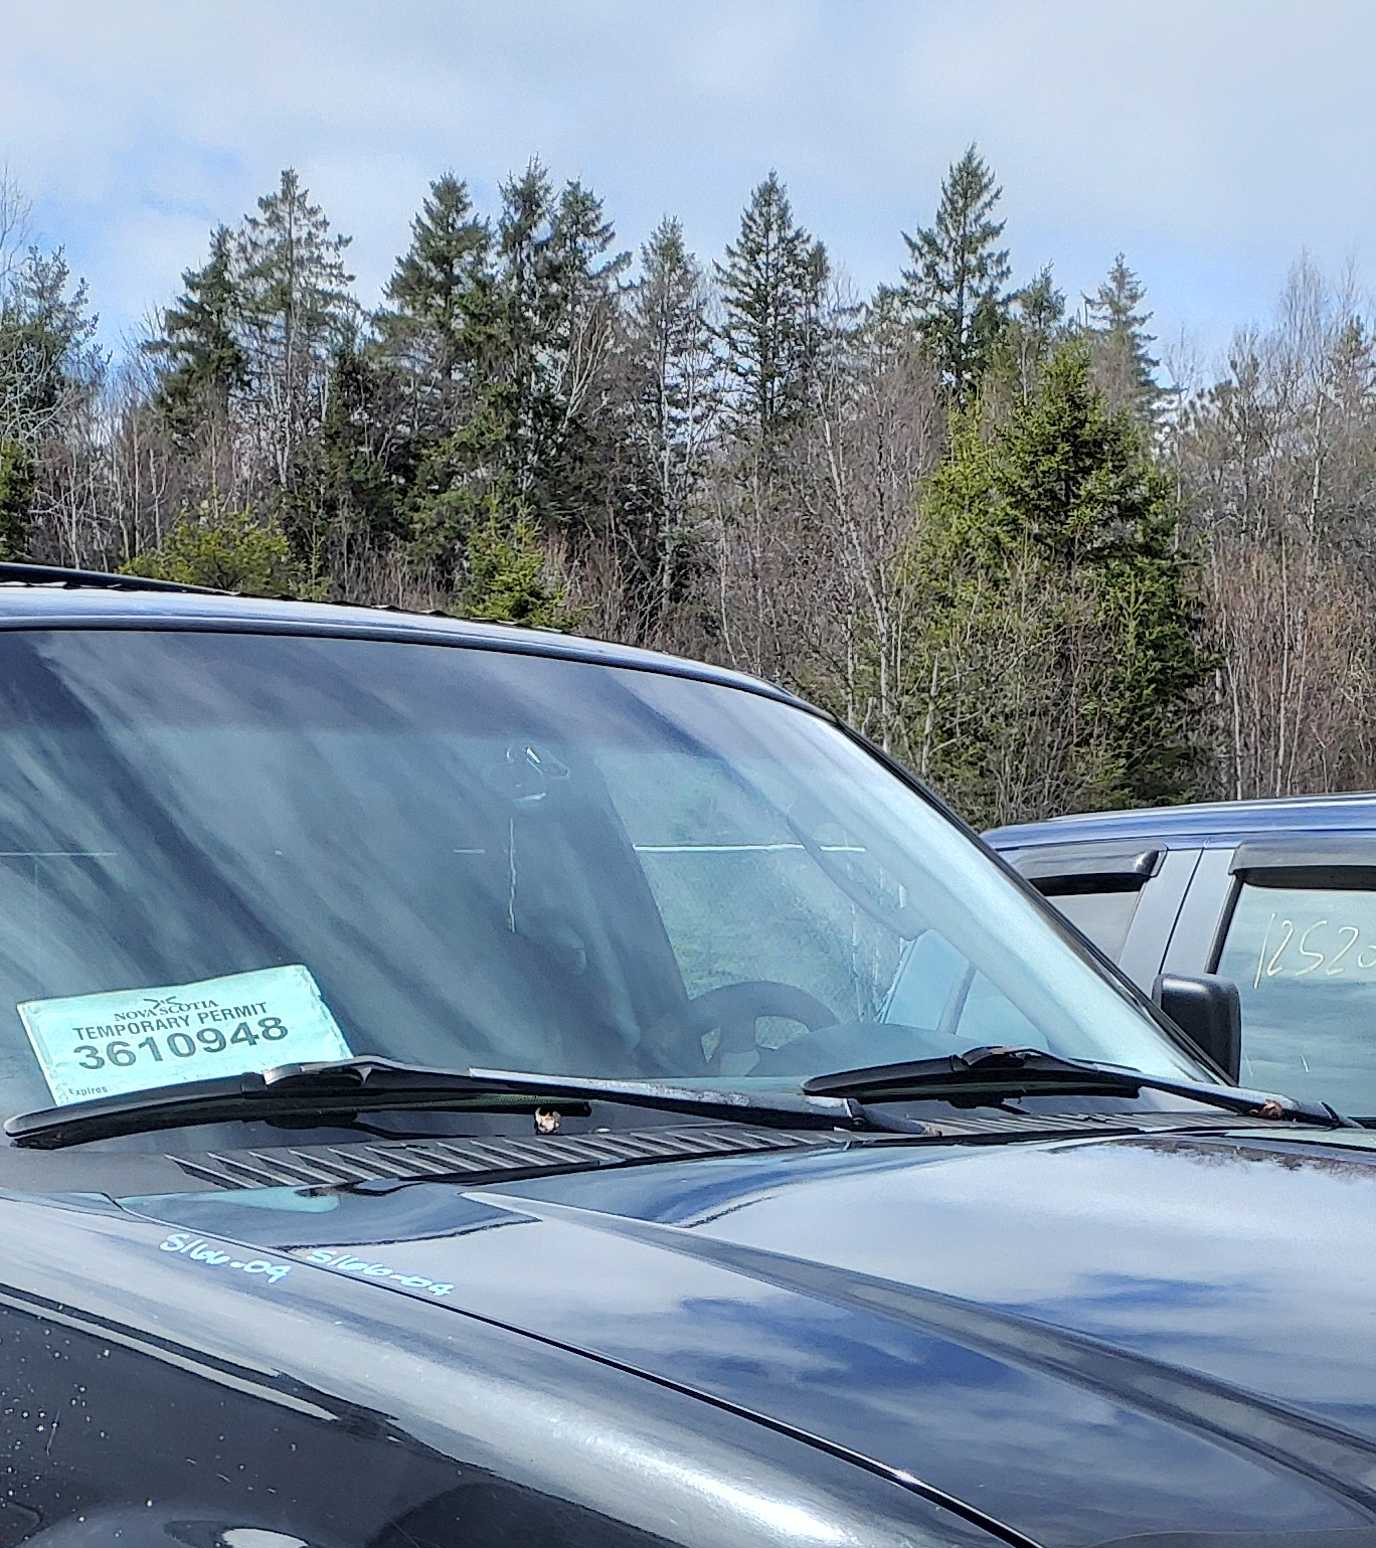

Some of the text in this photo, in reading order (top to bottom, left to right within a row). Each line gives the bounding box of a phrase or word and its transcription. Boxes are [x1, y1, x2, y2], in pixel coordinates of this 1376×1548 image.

[72, 1001, 269, 1042] TEMPORARY PERMIT
[113, 999, 219, 1023] NOVA SCOTIA
[73, 1016, 289, 1070] 3610948
